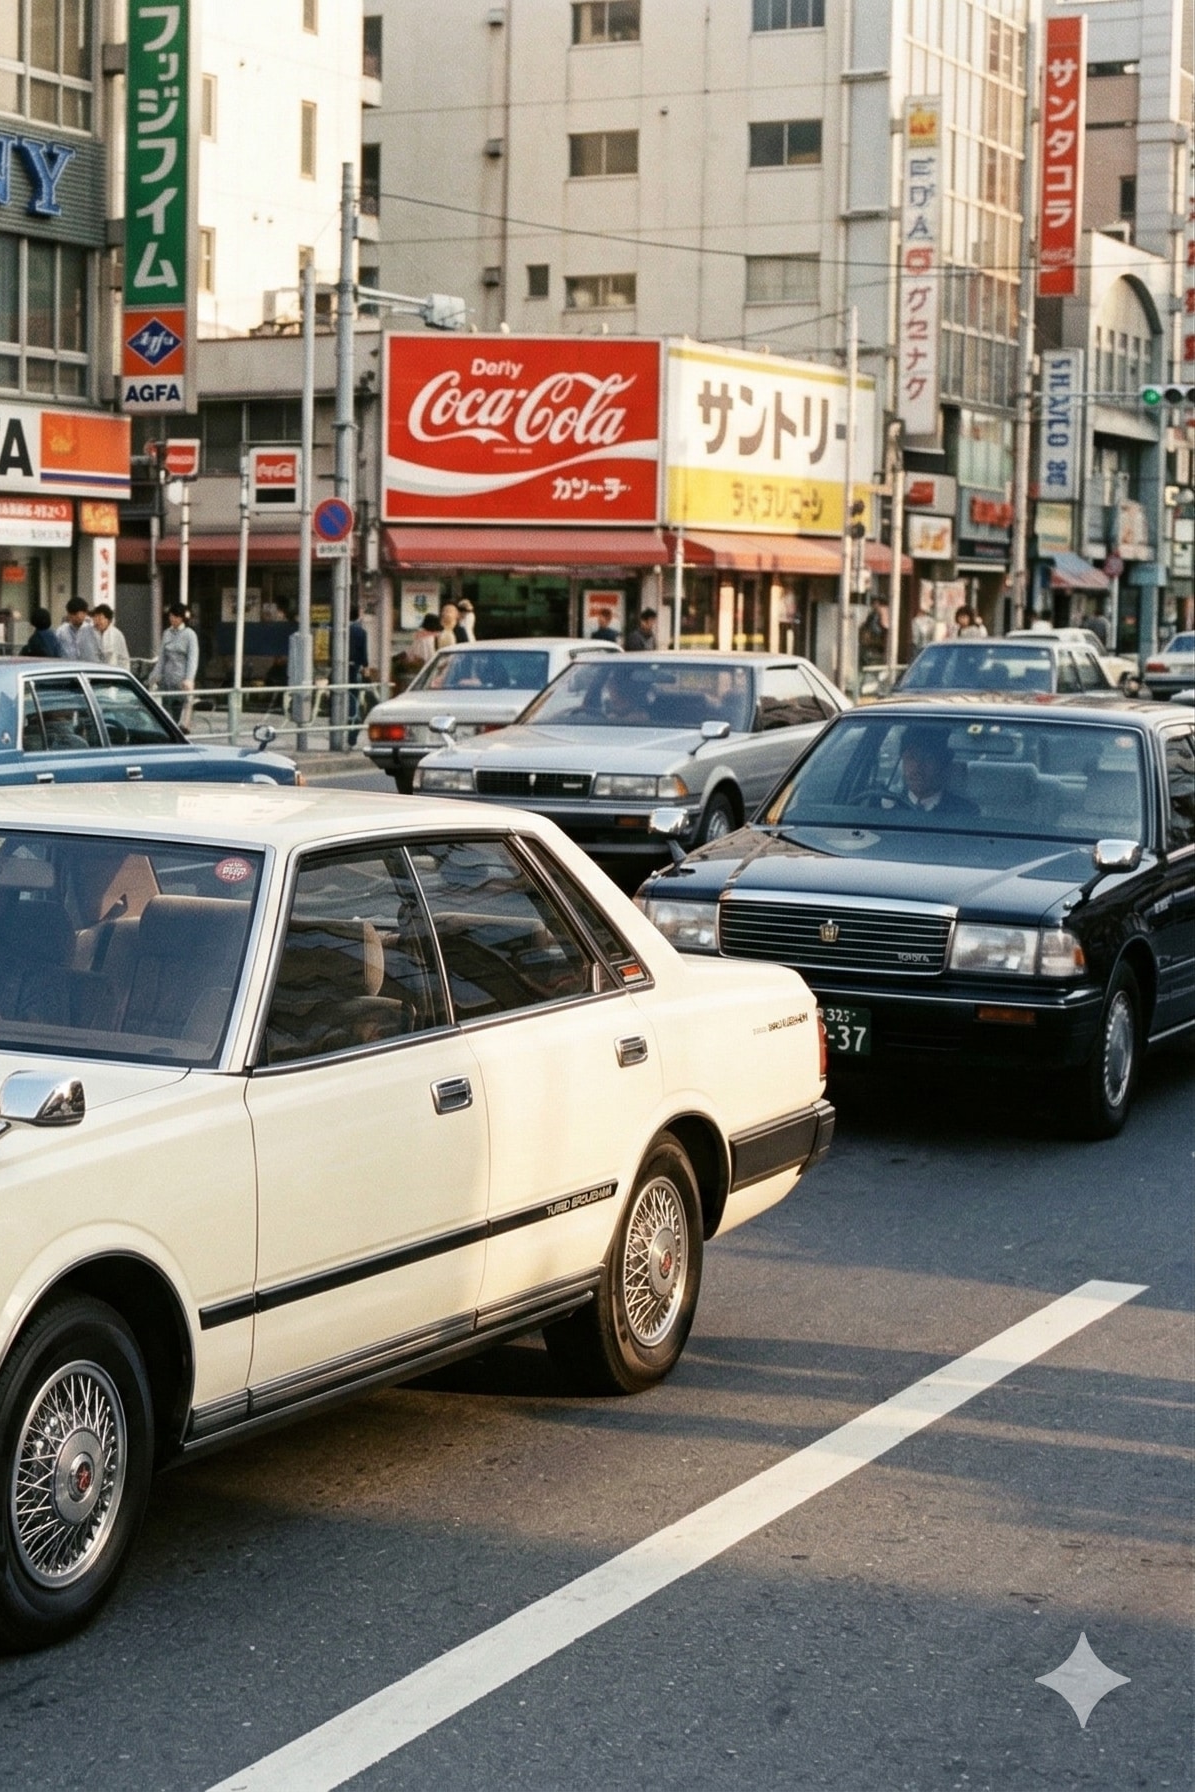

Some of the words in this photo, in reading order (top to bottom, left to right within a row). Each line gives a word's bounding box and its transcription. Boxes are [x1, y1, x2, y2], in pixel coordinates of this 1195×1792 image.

[125, 384, 181, 402] AGFA
[408, 370, 638, 445] Coca-Cola
[826, 1008, 850, 1023] 325
